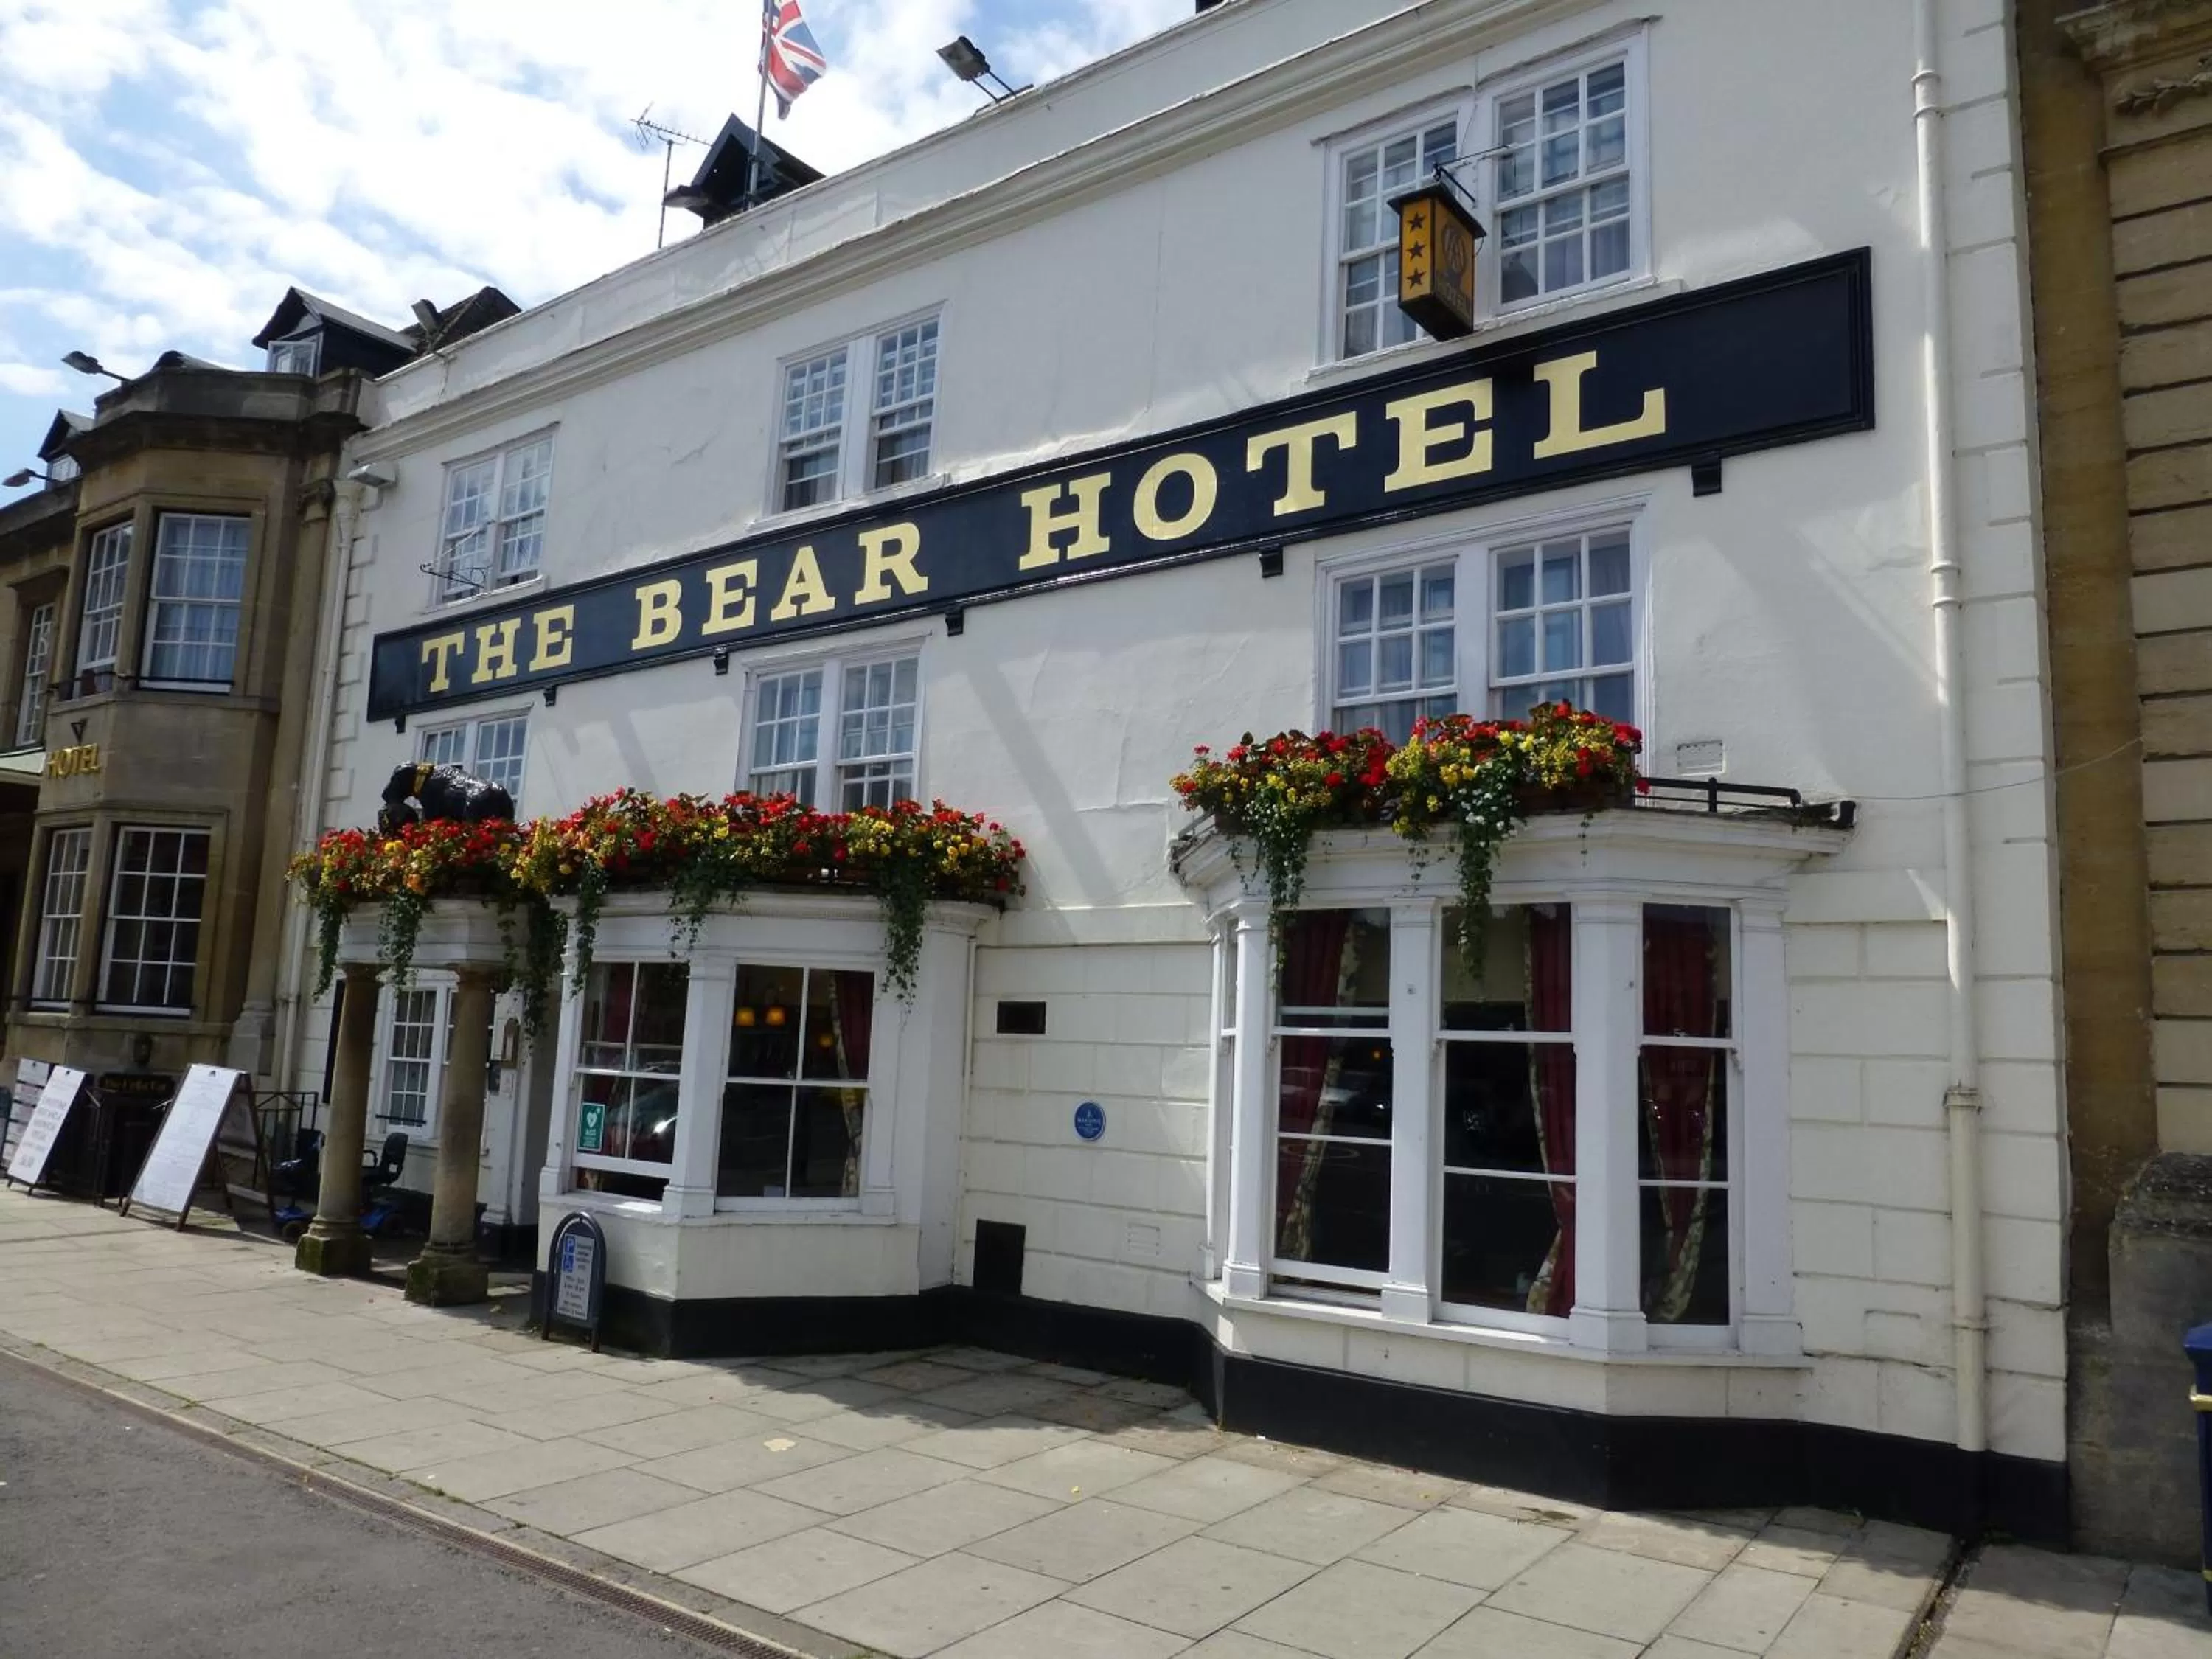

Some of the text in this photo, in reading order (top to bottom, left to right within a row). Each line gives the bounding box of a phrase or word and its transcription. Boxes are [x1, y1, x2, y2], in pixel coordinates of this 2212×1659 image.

[421, 350, 1667, 693] THE BEAR HOTEL
[47, 743, 100, 779] HOTEL
